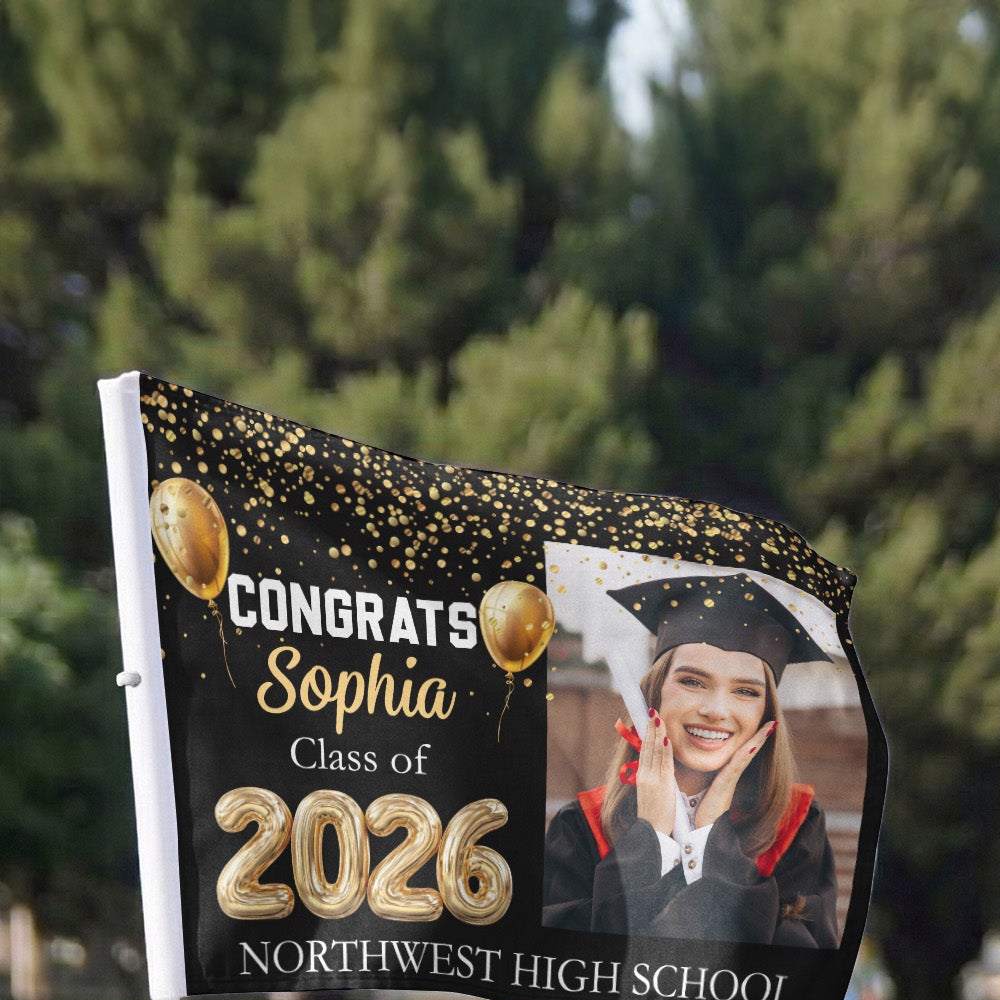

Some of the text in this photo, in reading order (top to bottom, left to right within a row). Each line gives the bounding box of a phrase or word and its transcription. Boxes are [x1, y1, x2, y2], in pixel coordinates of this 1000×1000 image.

[227, 573, 479, 649] CONGRATS
[256, 645, 457, 734] Sophia
[289, 736, 429, 776] Class of
[214, 786, 514, 926] 2026
[239, 939, 502, 984] NORTHWEST
[512, 951, 621, 997] HIGH
